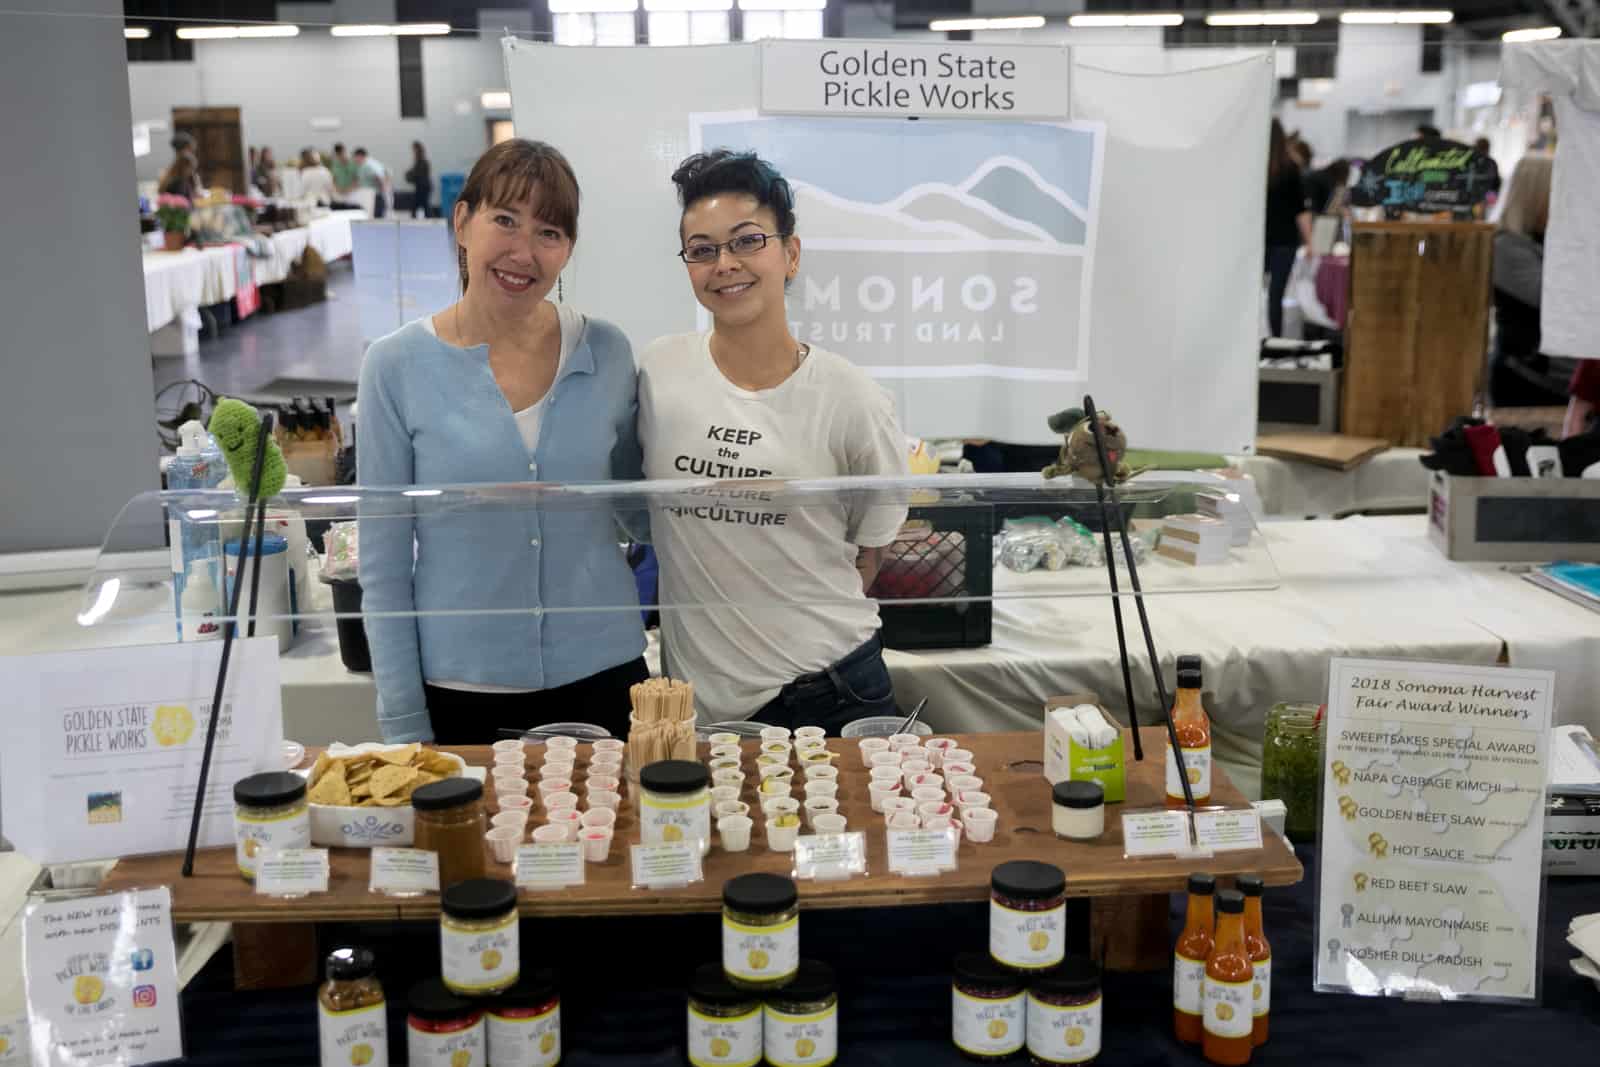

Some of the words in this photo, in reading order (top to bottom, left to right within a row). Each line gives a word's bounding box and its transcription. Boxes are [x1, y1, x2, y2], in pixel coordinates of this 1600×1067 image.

[819, 49, 927, 77] Golden
[938, 53, 1016, 79] State
[823, 81, 910, 108] Pickle
[920, 83, 1015, 110] Works
[707, 425, 762, 446] KEEP
[717, 447, 740, 459] the
[1351, 676, 1391, 691] 2018
[1395, 679, 1467, 697] Sonoma
[1472, 684, 1541, 701] Harvest
[1354, 695, 1393, 709] Fair
[1395, 698, 1455, 714] Award
[1457, 702, 1532, 720] Winners
[63, 707, 113, 732] GOLDEN
[117, 705, 149, 728] STATE
[65, 733, 103, 753] PICKLE
[107, 728, 147, 751] WORKS
[1432, 736, 1482, 751] SPECIAL
[1486, 740, 1536, 754] AWARD
[1352, 772, 1388, 784] NAPA
[1391, 775, 1450, 789] CABBAGE
[1456, 779, 1501, 792] KIMCHI
[1358, 807, 1413, 822] GOLDEN
[1416, 809, 1446, 824] BEET
[1450, 812, 1486, 826] SLAW
[1392, 845, 1420, 856] HOT
[1423, 847, 1465, 860] SAUCE
[1371, 878, 1395, 889] RED
[1399, 880, 1430, 892] BEET
[1432, 883, 1468, 895] SLAW
[99, 916, 161, 932] DISNTS
[1357, 912, 1401, 925] ALLIUM
[1405, 916, 1489, 933] MAYONNAISE
[1436, 955, 1482, 968] RADISH
